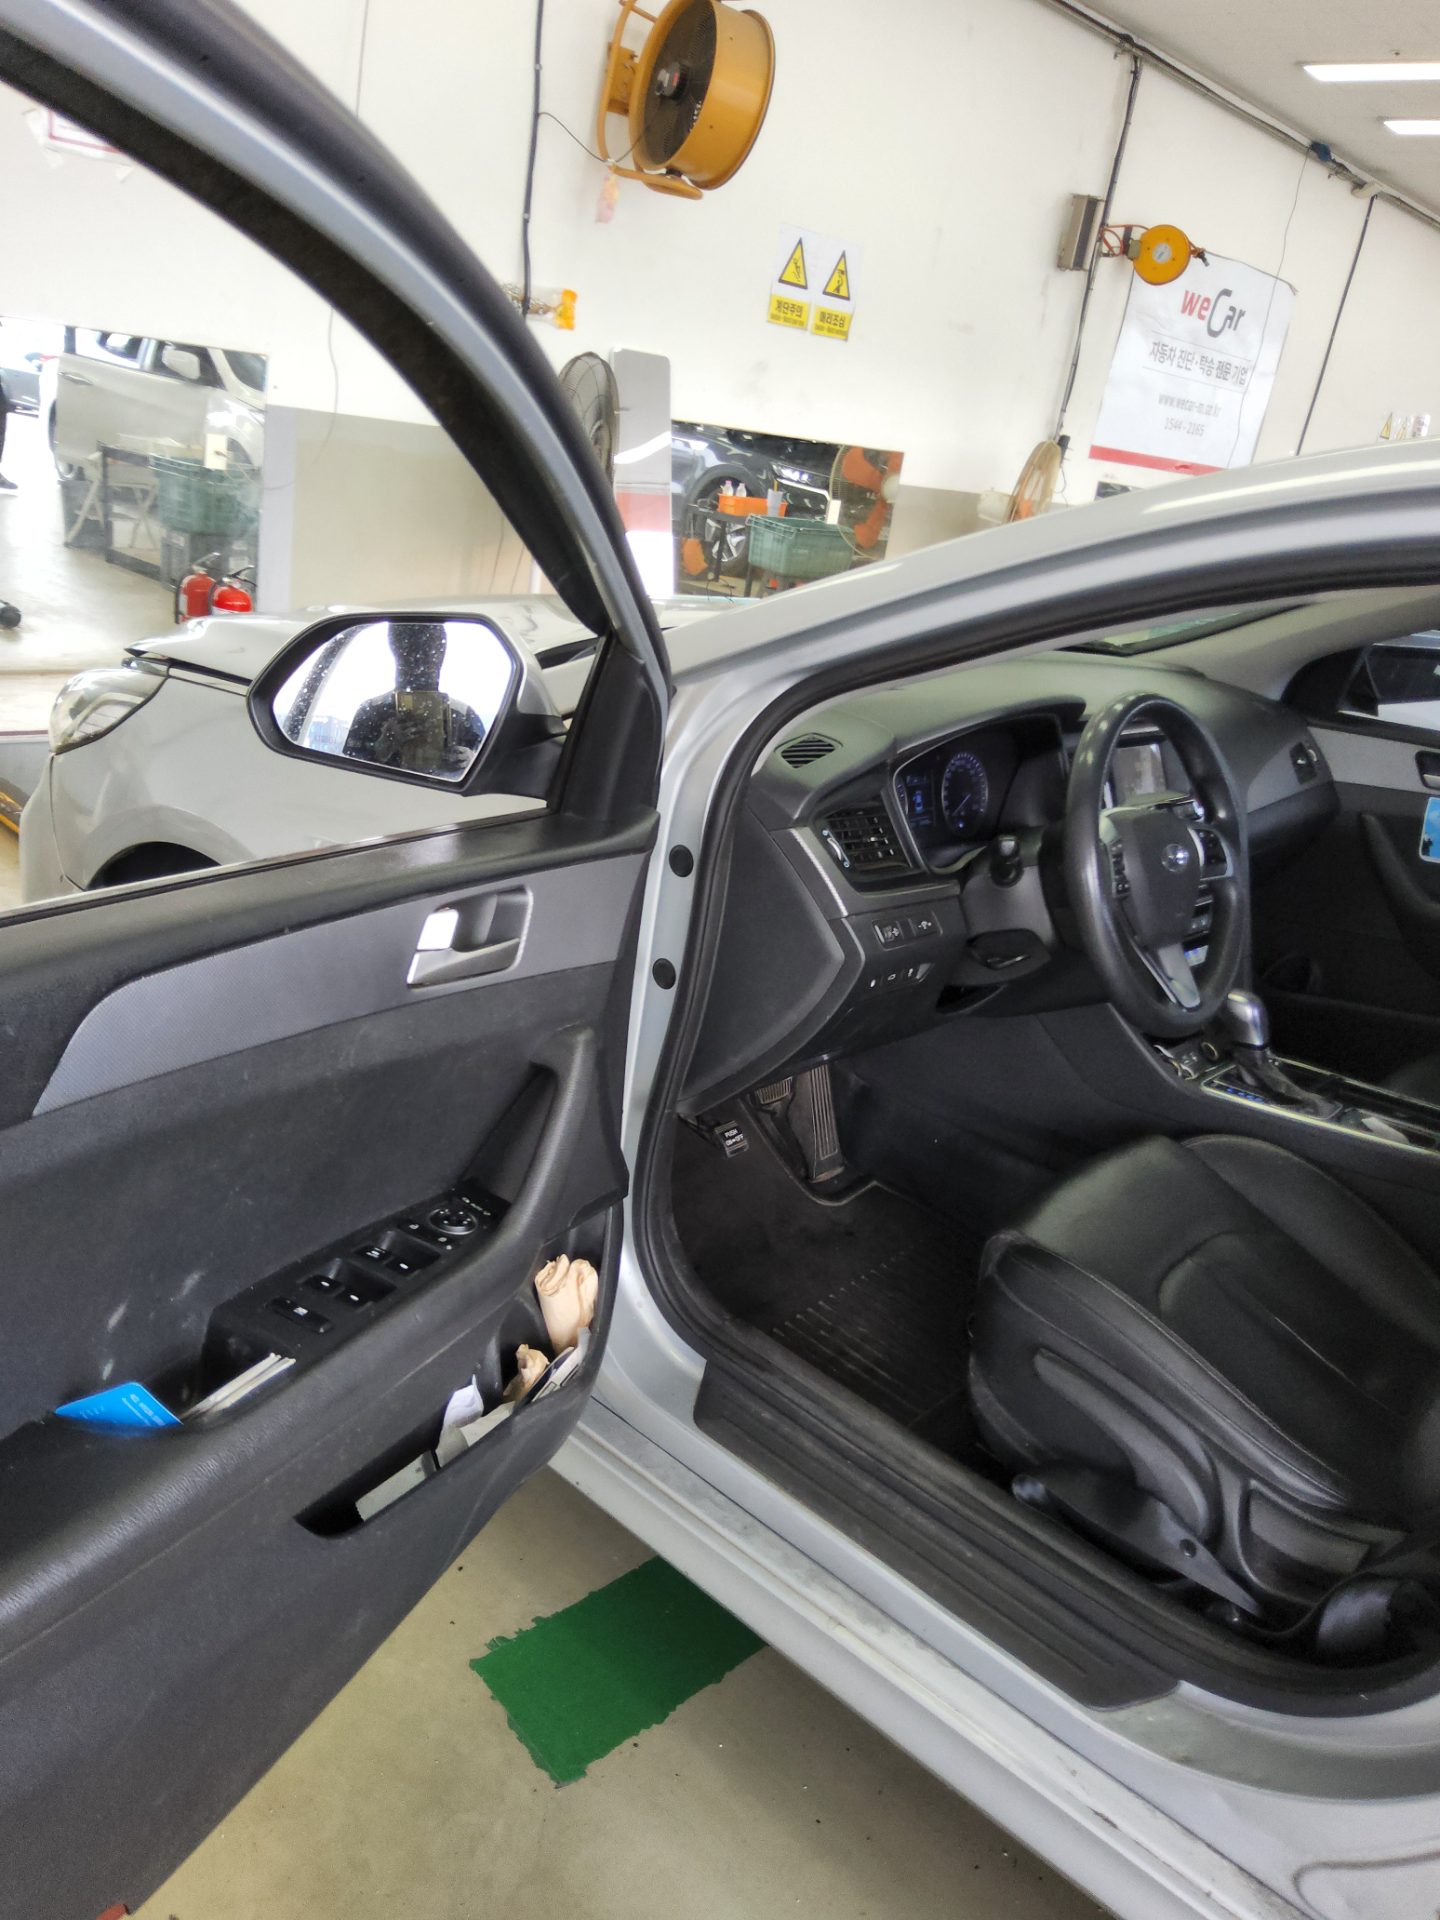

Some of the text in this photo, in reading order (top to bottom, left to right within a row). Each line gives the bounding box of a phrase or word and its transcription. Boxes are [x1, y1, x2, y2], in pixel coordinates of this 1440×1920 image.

[1149, 341, 1177, 367] 자동차
[1215, 360, 1232, 381] 전문
[1232, 365, 1249, 386] 기업
